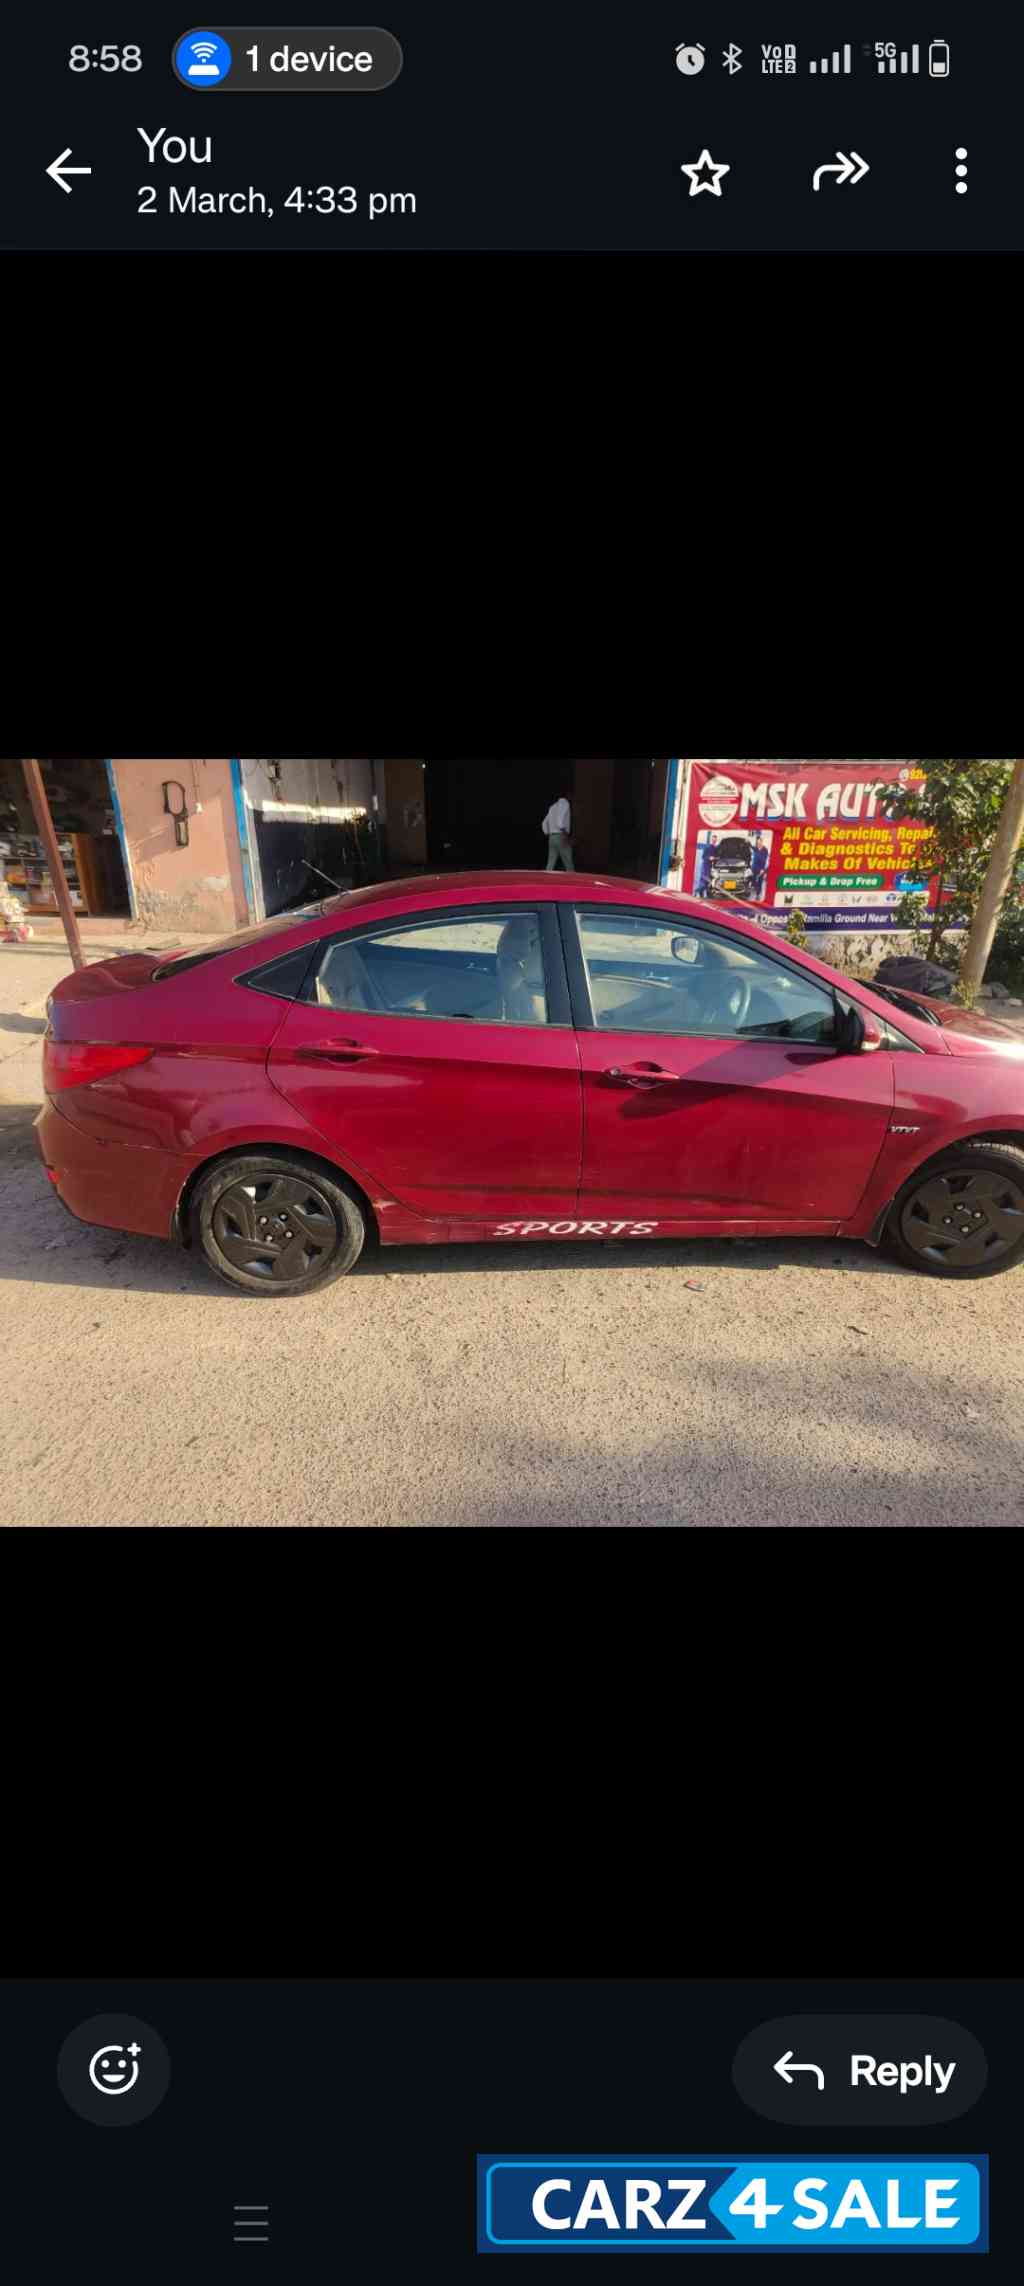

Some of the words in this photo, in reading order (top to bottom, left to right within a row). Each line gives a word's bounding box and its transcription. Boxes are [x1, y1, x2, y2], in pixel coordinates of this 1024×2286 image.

[739, 782, 809, 818] MSK
[783, 826, 801, 841] All
[804, 826, 826, 841] Car
[831, 826, 893, 842] Servicing,
[896, 826, 937, 842] Repai
[780, 842, 793, 856] &
[798, 842, 895, 858] Diagnostics
[784, 857, 838, 871] Makes
[843, 857, 863, 871] Of
[783, 877, 817, 887] Pickup
[819, 877, 827, 886] &
[830, 877, 853, 887] Drop
[856, 877, 878, 886] Free
[834, 913, 866, 924] Ground
[868, 913, 888, 923] Near
[493, 1220, 659, 1236] SPORTS
